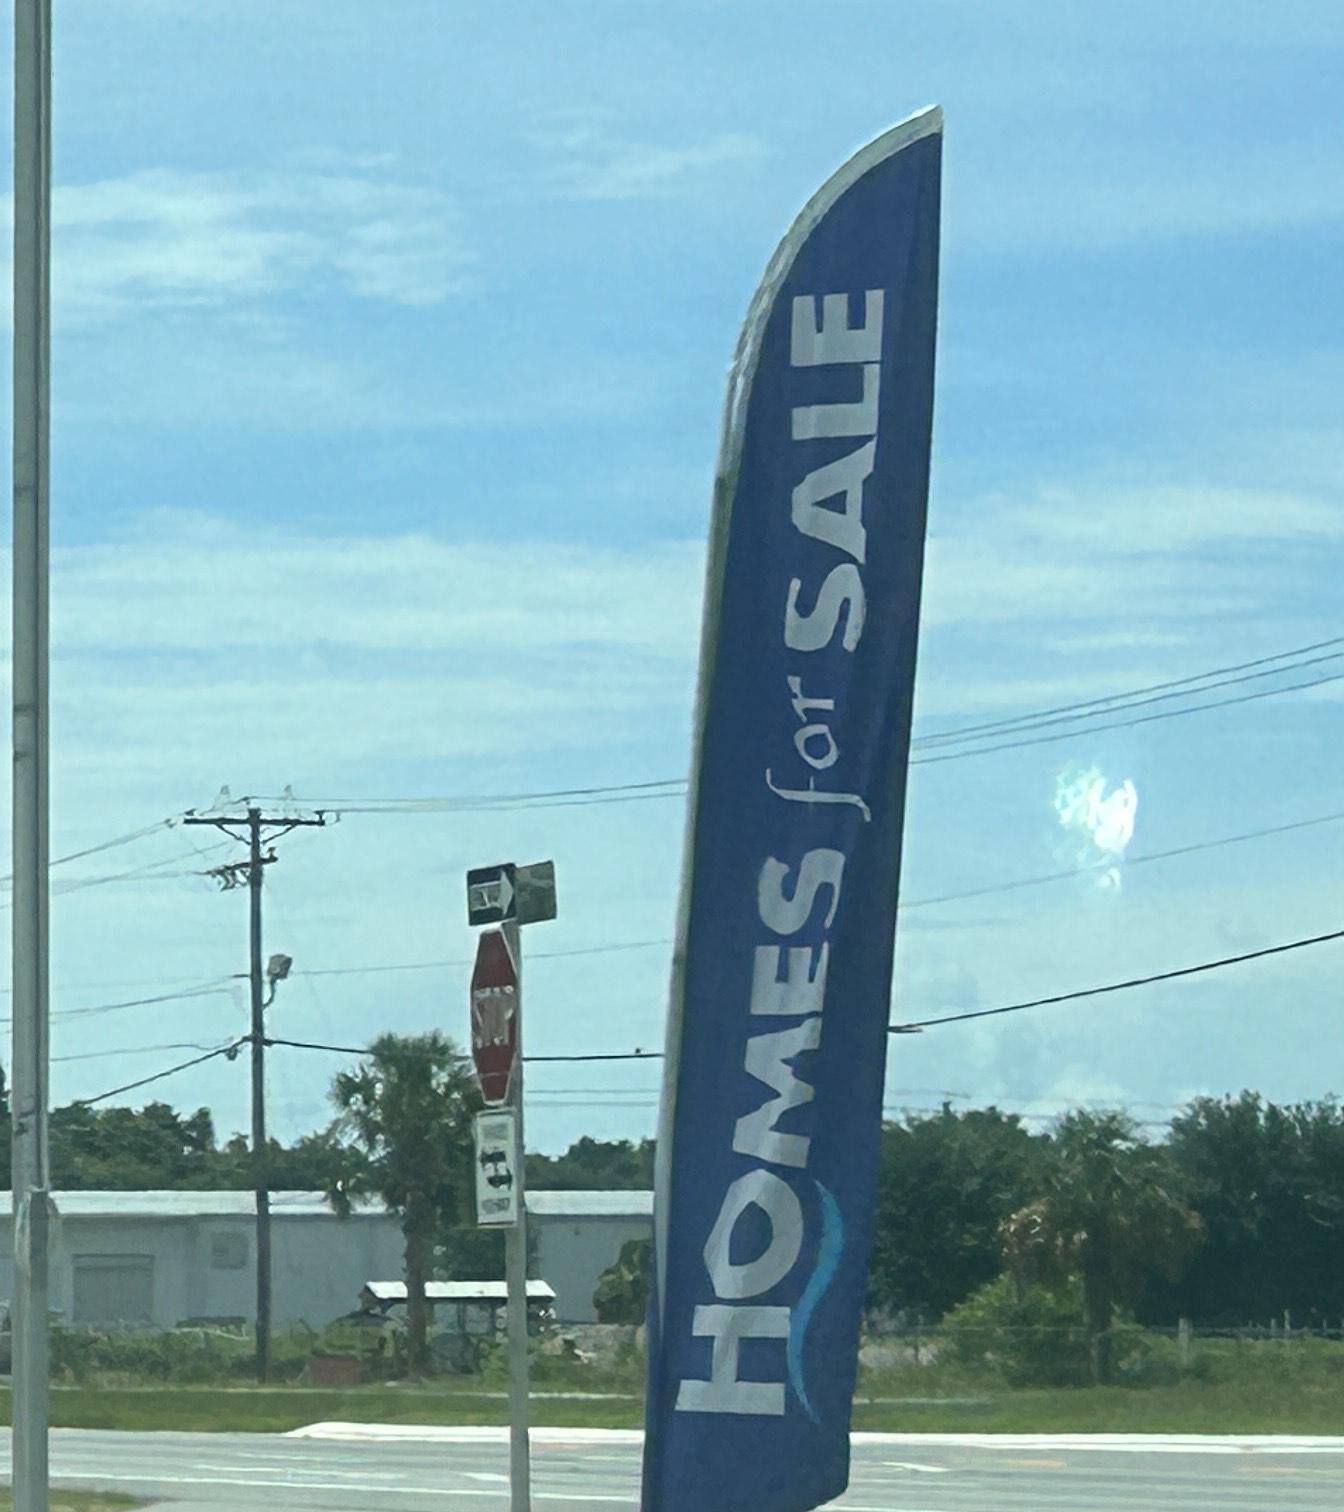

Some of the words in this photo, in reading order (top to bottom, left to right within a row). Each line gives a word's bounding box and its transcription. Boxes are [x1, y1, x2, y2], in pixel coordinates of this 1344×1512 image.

[784, 287, 885, 654] SALE
[765, 674, 871, 822] for
[674, 847, 846, 1416] HOMES
